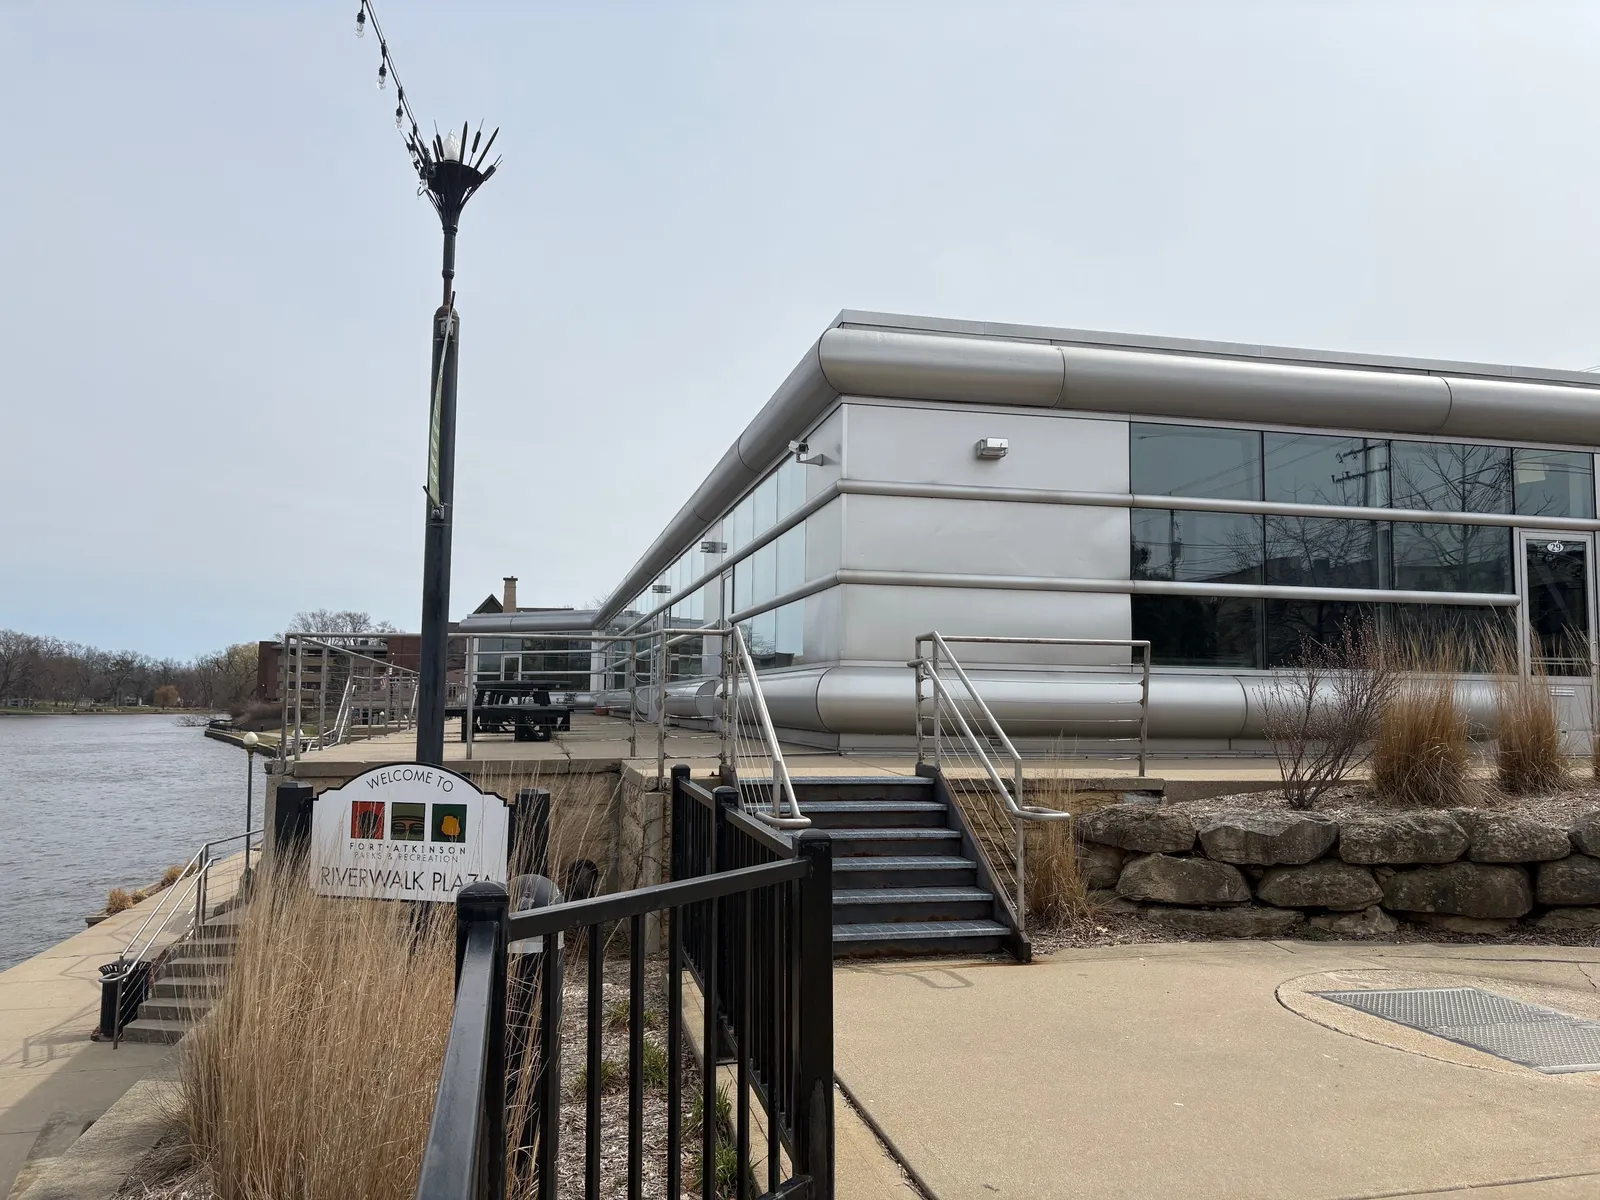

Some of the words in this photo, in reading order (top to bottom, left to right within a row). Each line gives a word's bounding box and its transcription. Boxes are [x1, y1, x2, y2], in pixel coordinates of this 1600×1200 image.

[366, 768, 434, 791] WELCOME
[437, 775, 455, 793] TO
[349, 842, 384, 852] FORT
[393, 844, 467, 855] ATKINSON
[354, 851, 383, 860] PARKS
[398, 853, 459, 863] RECREATION
[320, 866, 425, 892] RIVERWALK
